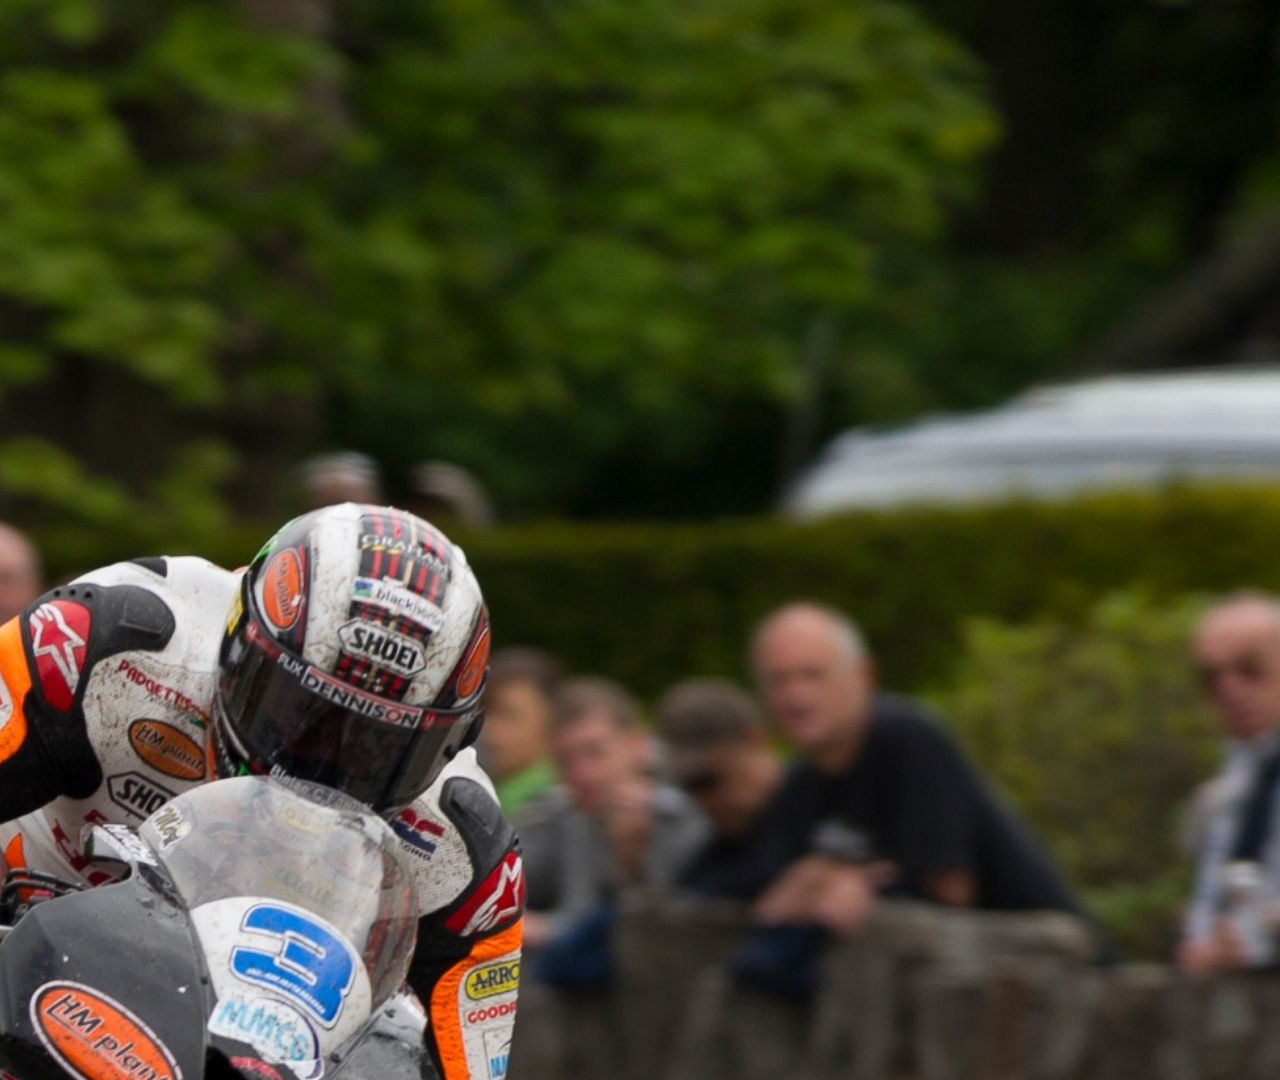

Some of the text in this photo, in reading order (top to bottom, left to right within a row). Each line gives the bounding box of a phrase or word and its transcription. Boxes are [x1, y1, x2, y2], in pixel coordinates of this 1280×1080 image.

[349, 627, 419, 671] SHOEI
[304, 672, 420, 728] DENNISON
[135, 724, 165, 746] HM
[116, 777, 169, 815] SHO
[228, 903, 357, 1031] 3
[471, 963, 520, 991] ARRO
[46, 994, 103, 1034] HM
